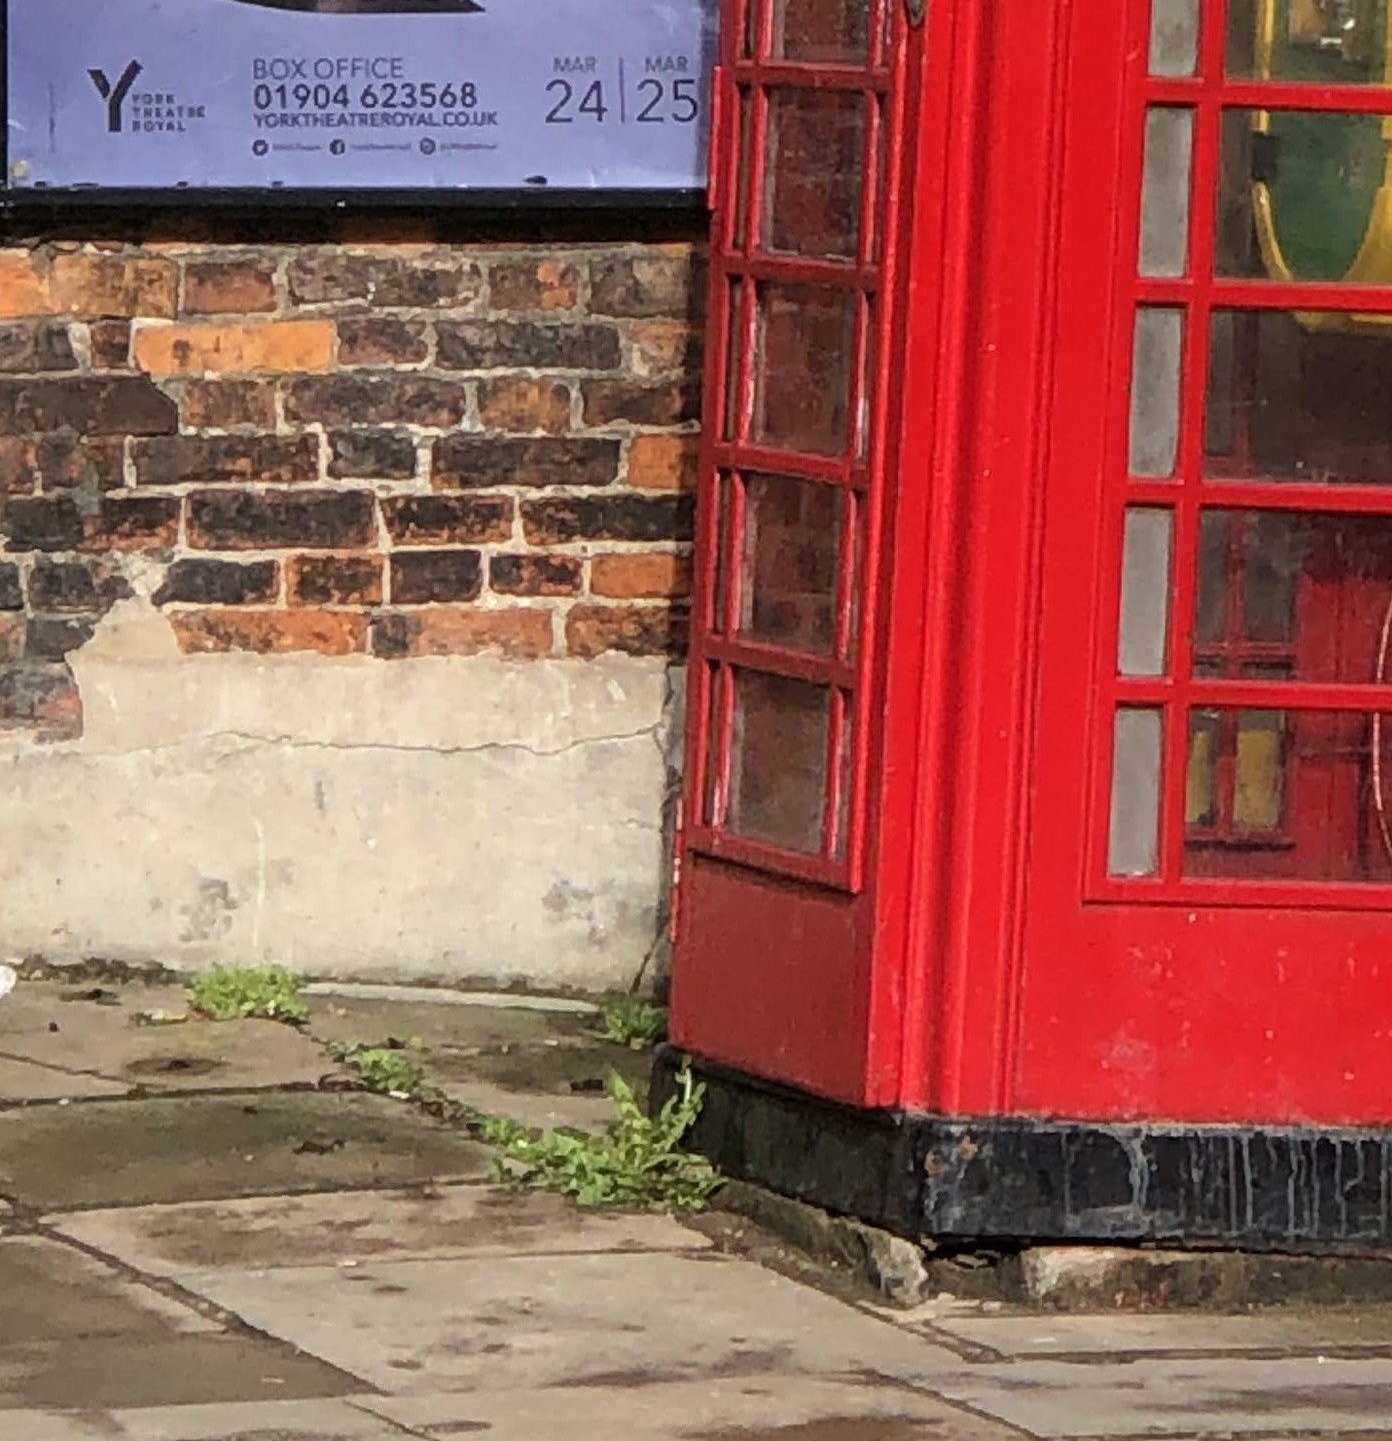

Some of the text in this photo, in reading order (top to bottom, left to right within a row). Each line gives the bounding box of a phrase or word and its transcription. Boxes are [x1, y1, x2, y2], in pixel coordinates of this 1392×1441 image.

[253, 57, 403, 80] BOX OFFICE
[553, 56, 598, 73] MAR
[645, 56, 689, 73] MAR
[253, 82, 477, 110] 01904 623568
[545, 79, 608, 124] 24
[637, 78, 698, 123] 25
[253, 111, 498, 128] YORKTHEATREROYAL.CO.UK
